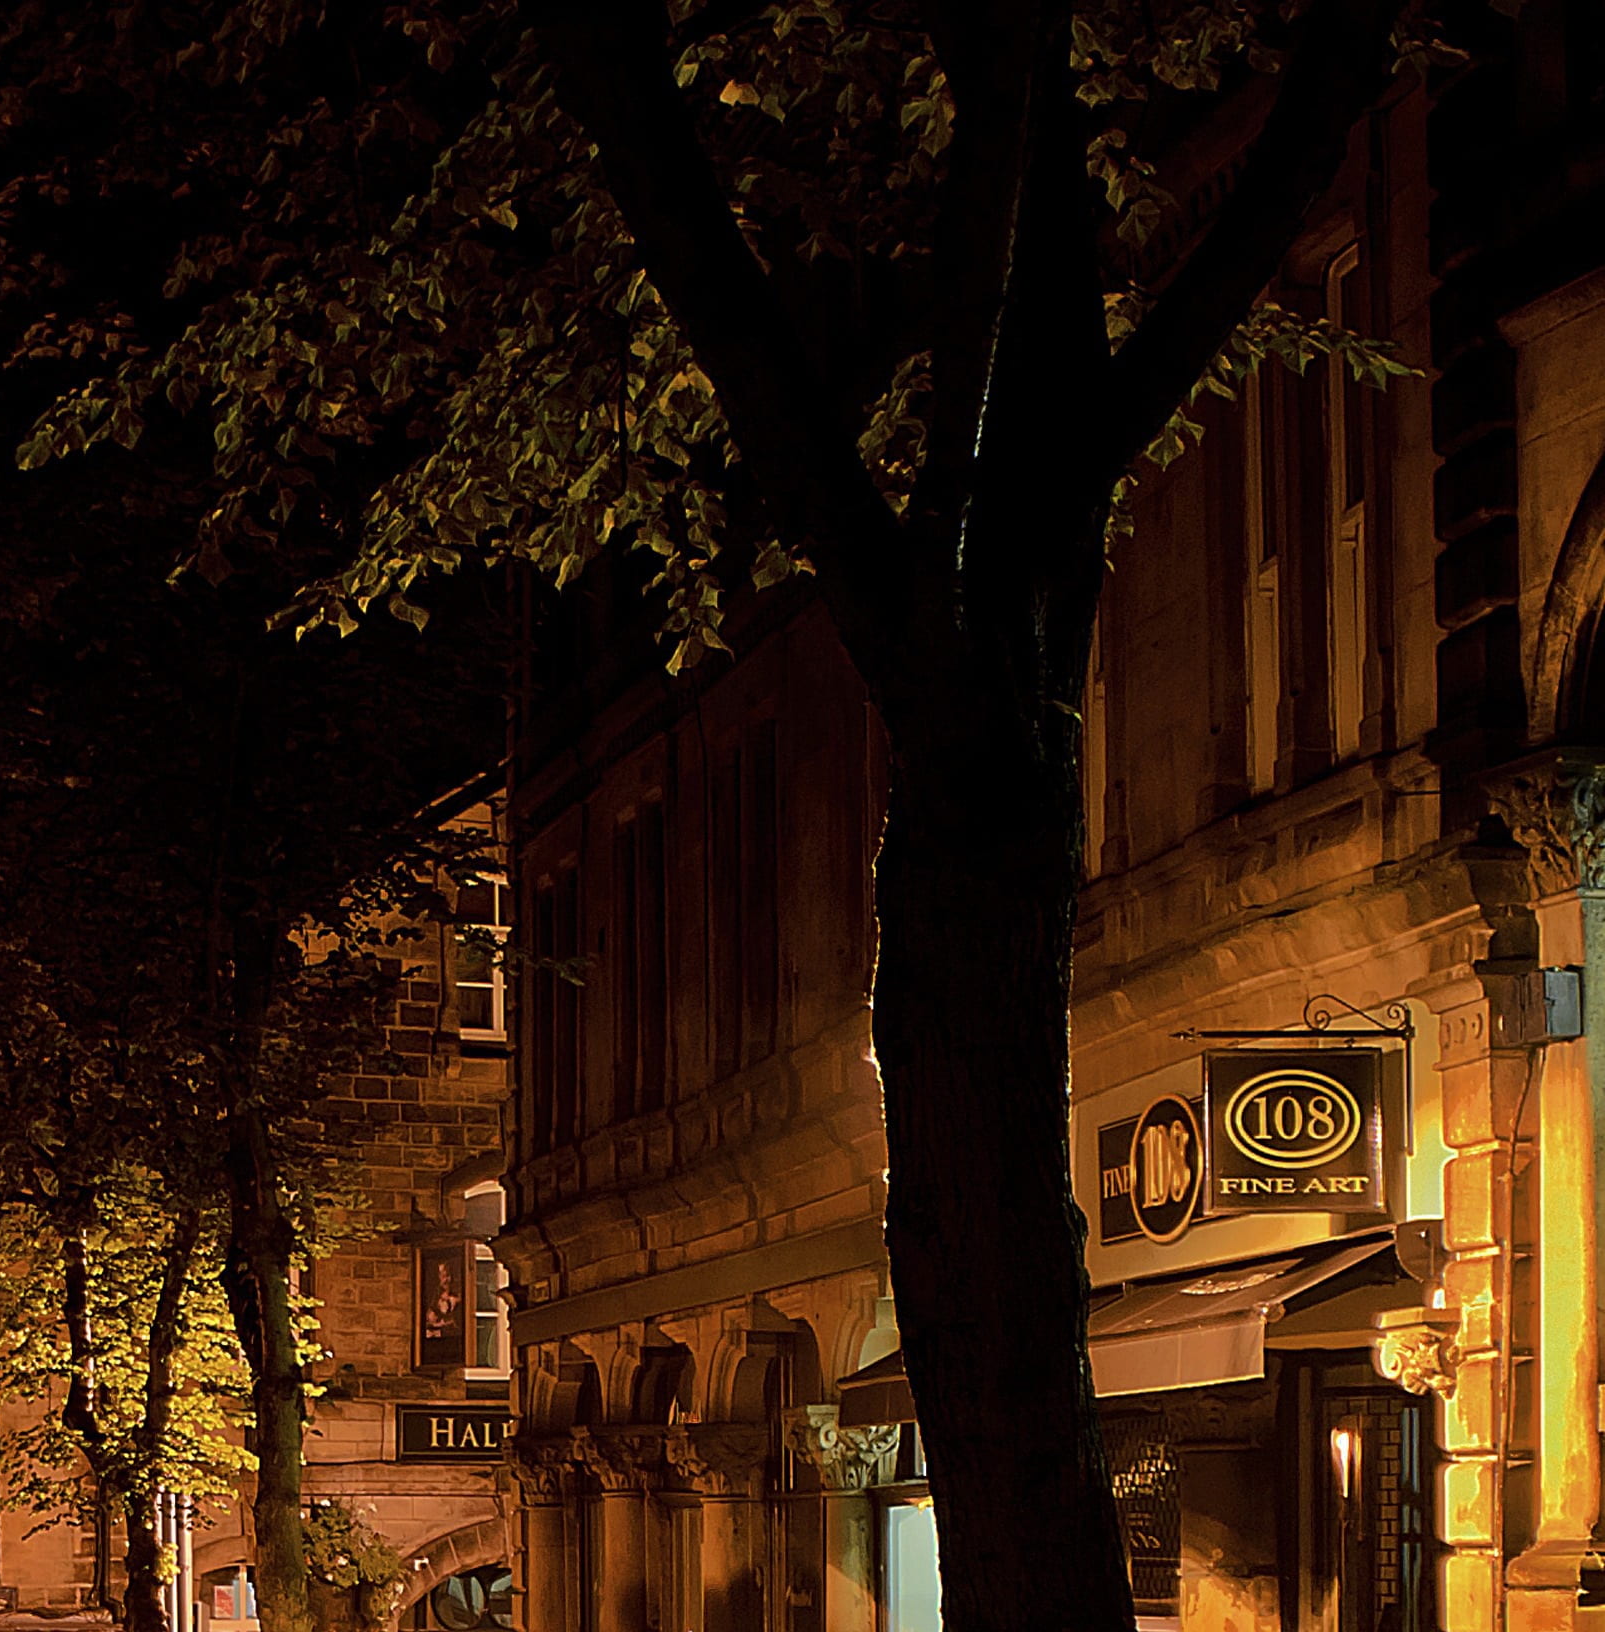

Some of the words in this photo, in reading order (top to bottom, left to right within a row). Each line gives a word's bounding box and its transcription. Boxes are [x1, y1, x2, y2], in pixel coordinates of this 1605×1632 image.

[1253, 1096, 1335, 1140] 108
[1103, 1165, 1131, 1198] FINE
[1140, 1120, 1191, 1208] 108
[1220, 1178, 1295, 1194] FINE
[1303, 1177, 1370, 1193] ART
